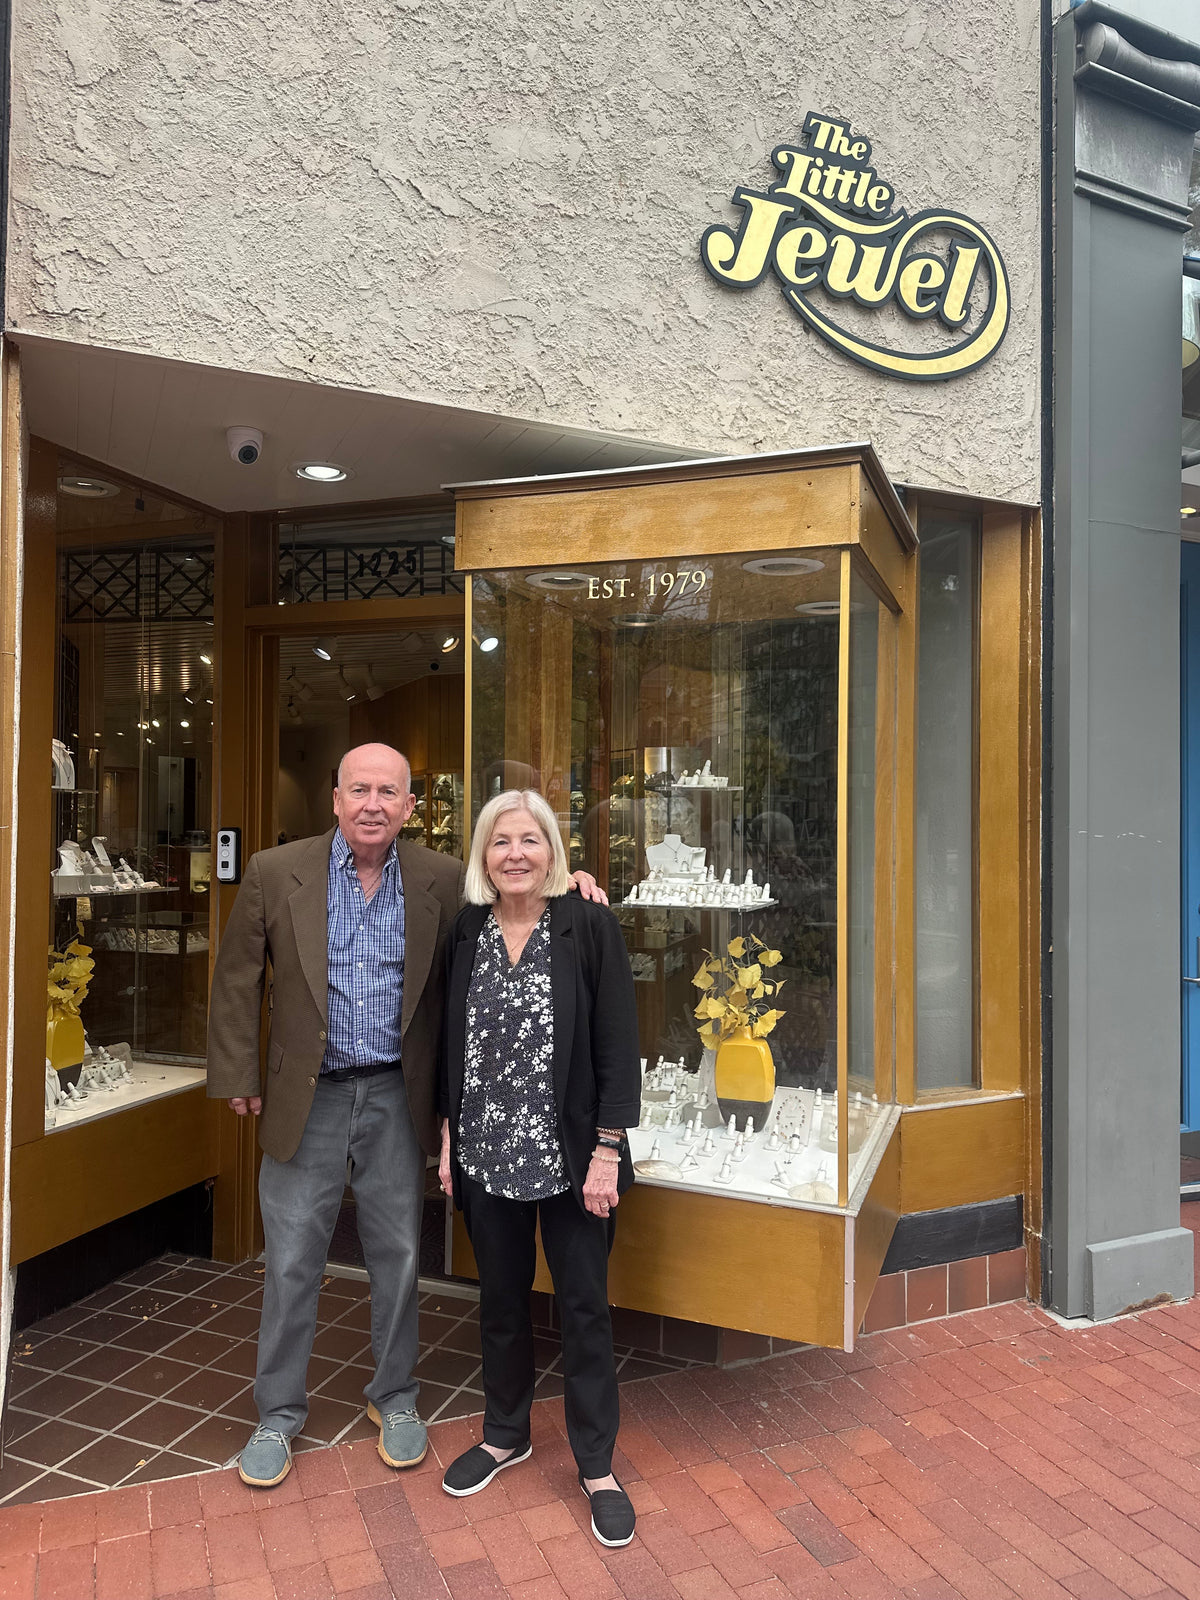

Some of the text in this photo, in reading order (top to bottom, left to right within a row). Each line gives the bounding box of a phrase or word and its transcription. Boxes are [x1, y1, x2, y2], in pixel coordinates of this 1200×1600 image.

[809, 117, 868, 161] The
[775, 150, 904, 235] Little
[706, 194, 1009, 376] Jewel
[357, 549, 417, 577] 1225
[586, 570, 707, 600] EST. 1979
